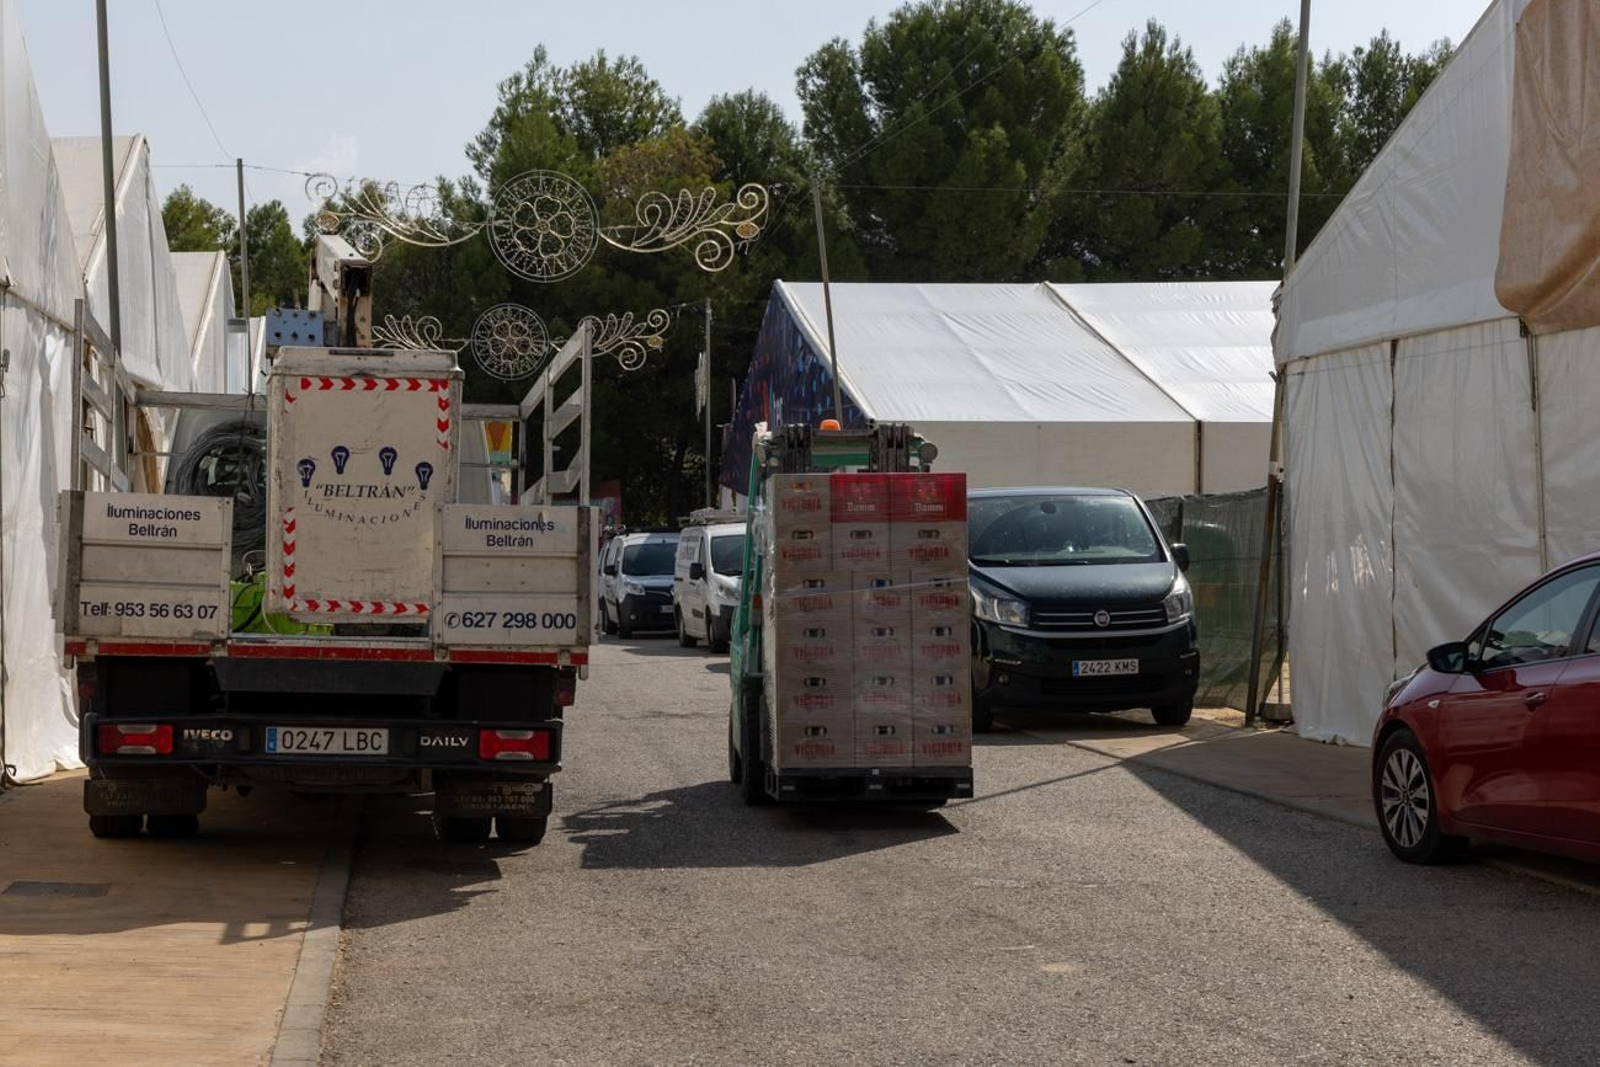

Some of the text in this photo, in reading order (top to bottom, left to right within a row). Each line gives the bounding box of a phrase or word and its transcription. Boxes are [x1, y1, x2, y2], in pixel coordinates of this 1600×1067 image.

[303, 489, 427, 525] ILUMINACIONES
[846, 502, 876, 512] Damm
[914, 502, 944, 512] Damm
[128, 521, 178, 538] Beltrán
[486, 534, 533, 548] Beltrán
[115, 602, 146, 617] 953
[149, 603, 170, 618] 56
[174, 604, 195, 619] 63
[197, 605, 218, 620] 07
[462, 612, 577, 630] 627 298 000
[1081, 660, 1137, 674] 2422 KMS
[183, 728, 234, 741] IVECO
[282, 730, 382, 751] 0247 LBC
[419, 734, 470, 748] DAILY
